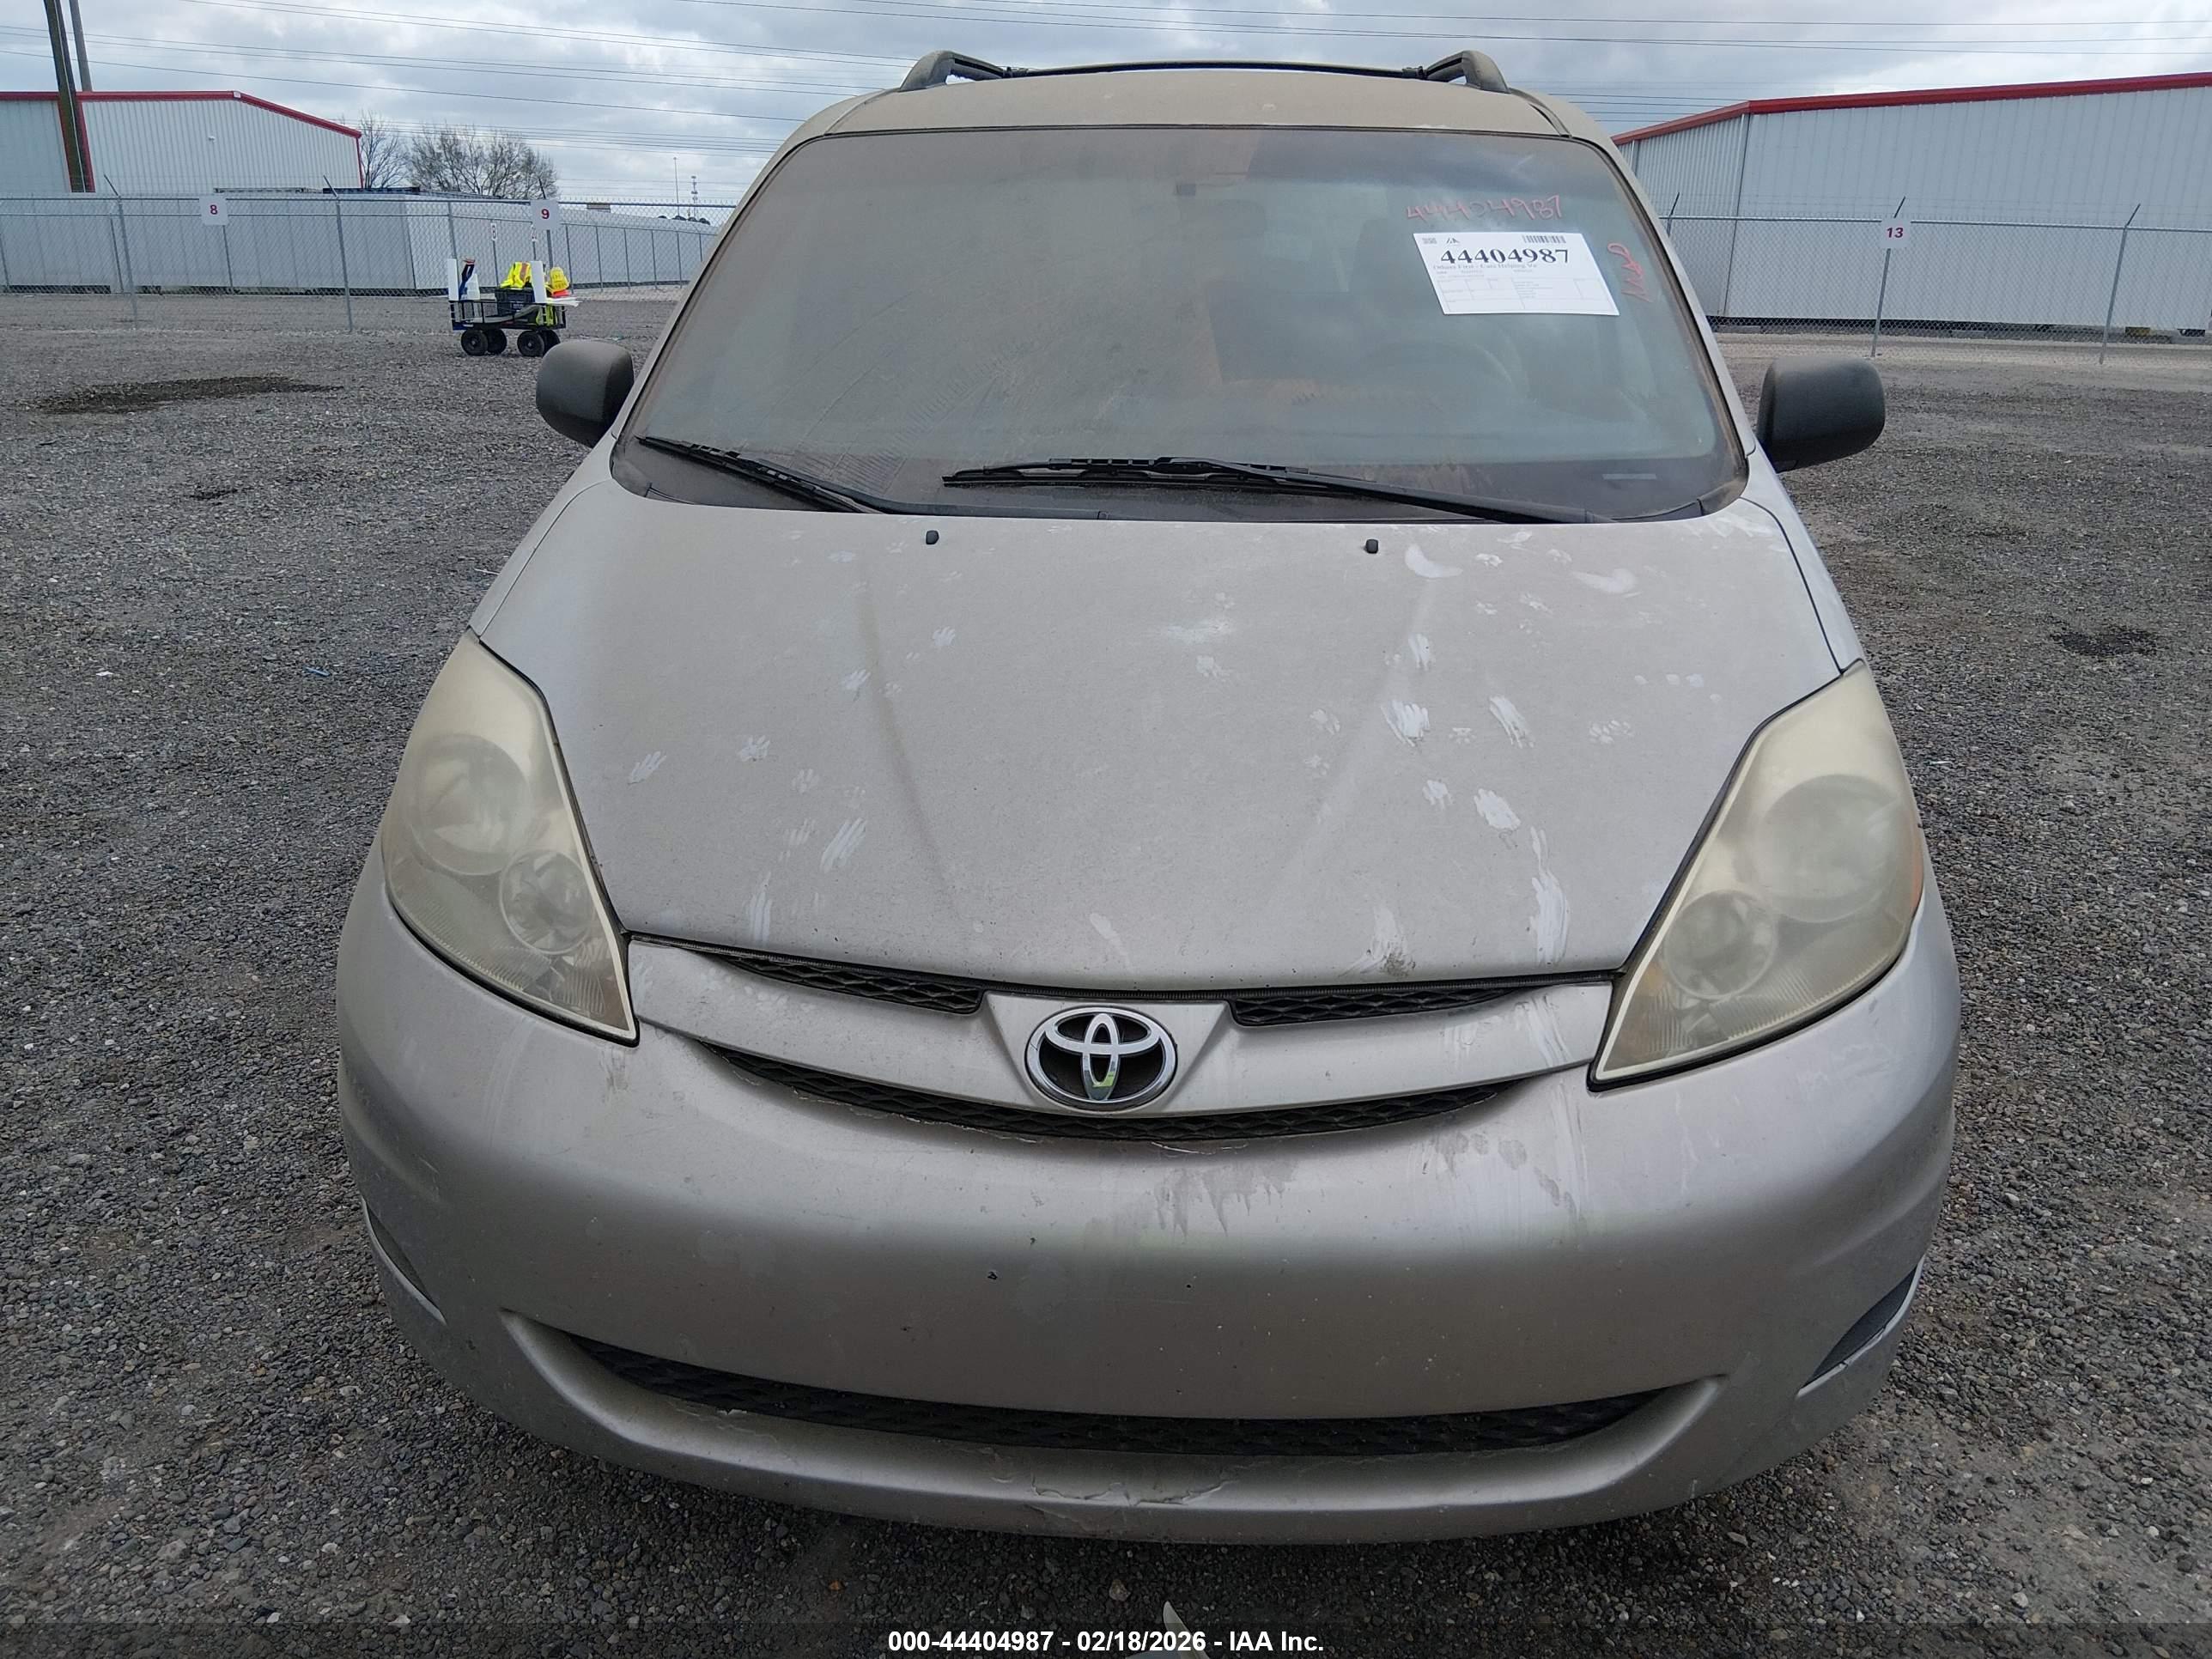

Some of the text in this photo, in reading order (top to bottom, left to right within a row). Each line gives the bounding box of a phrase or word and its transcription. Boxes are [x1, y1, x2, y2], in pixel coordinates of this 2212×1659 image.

[210, 204, 218, 215] 8
[541, 209, 550, 219] 9
[1887, 227, 1904, 239] 13
[1440, 248, 1569, 264] 44404987
